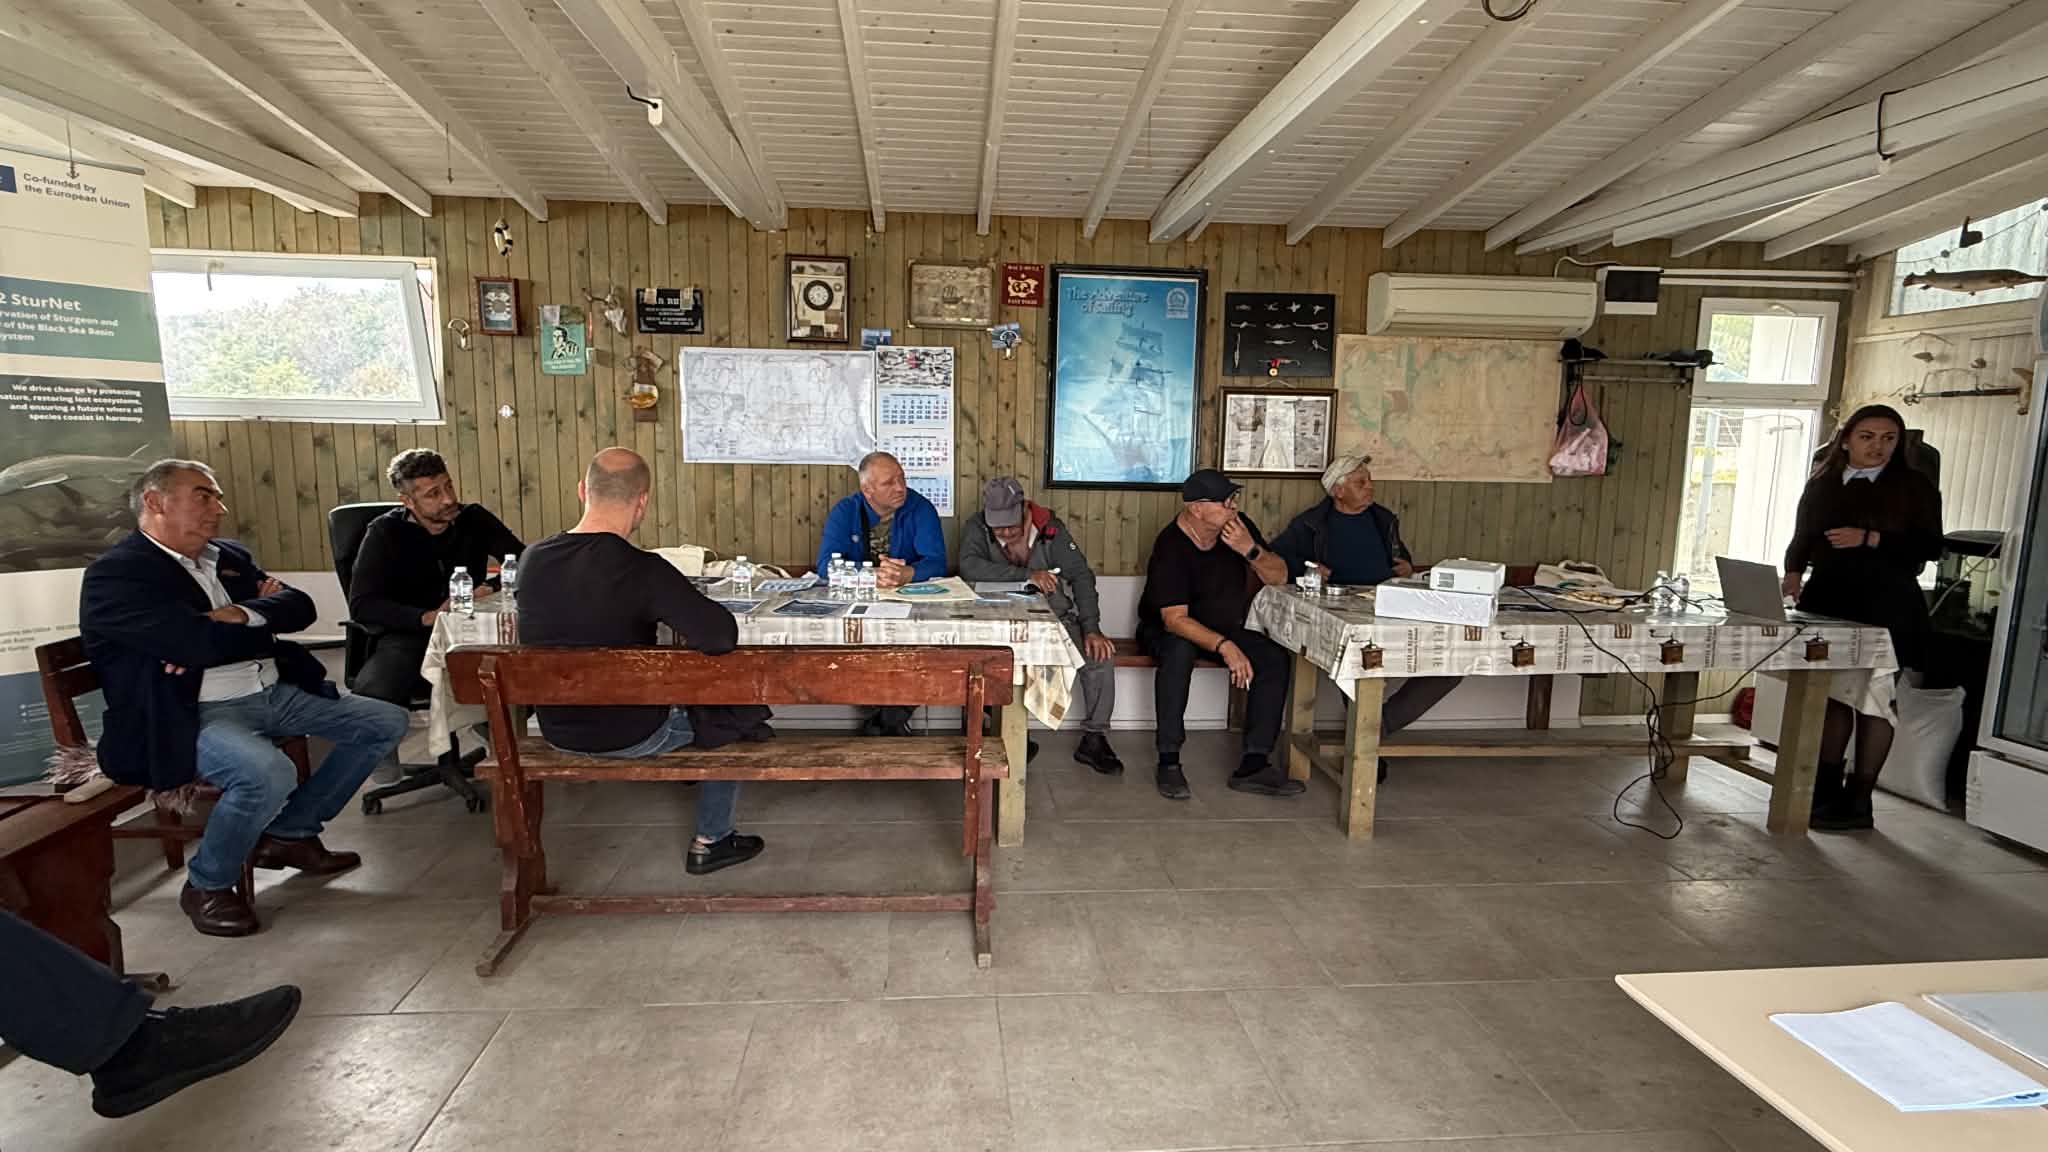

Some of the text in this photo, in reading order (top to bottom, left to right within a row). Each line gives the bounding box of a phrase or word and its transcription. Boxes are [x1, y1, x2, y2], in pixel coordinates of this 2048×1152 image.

[23, 172, 97, 193] Co-funded by
[24, 185, 131, 208] the European Union
[1066, 286, 1089, 301] The
[11, 293, 81, 311] SturNet
[40, 313, 51, 321] of
[53, 314, 98, 325] Sturgeon
[100, 319, 119, 327] and
[4, 320, 115, 337] of the Black Sea Basin
[12, 384, 28, 392] We
[28, 384, 52, 393] drive
[54, 385, 86, 394] change
[87, 387, 98, 395] by
[29, 404, 69, 412] ensuring
[29, 413, 62, 421] species
